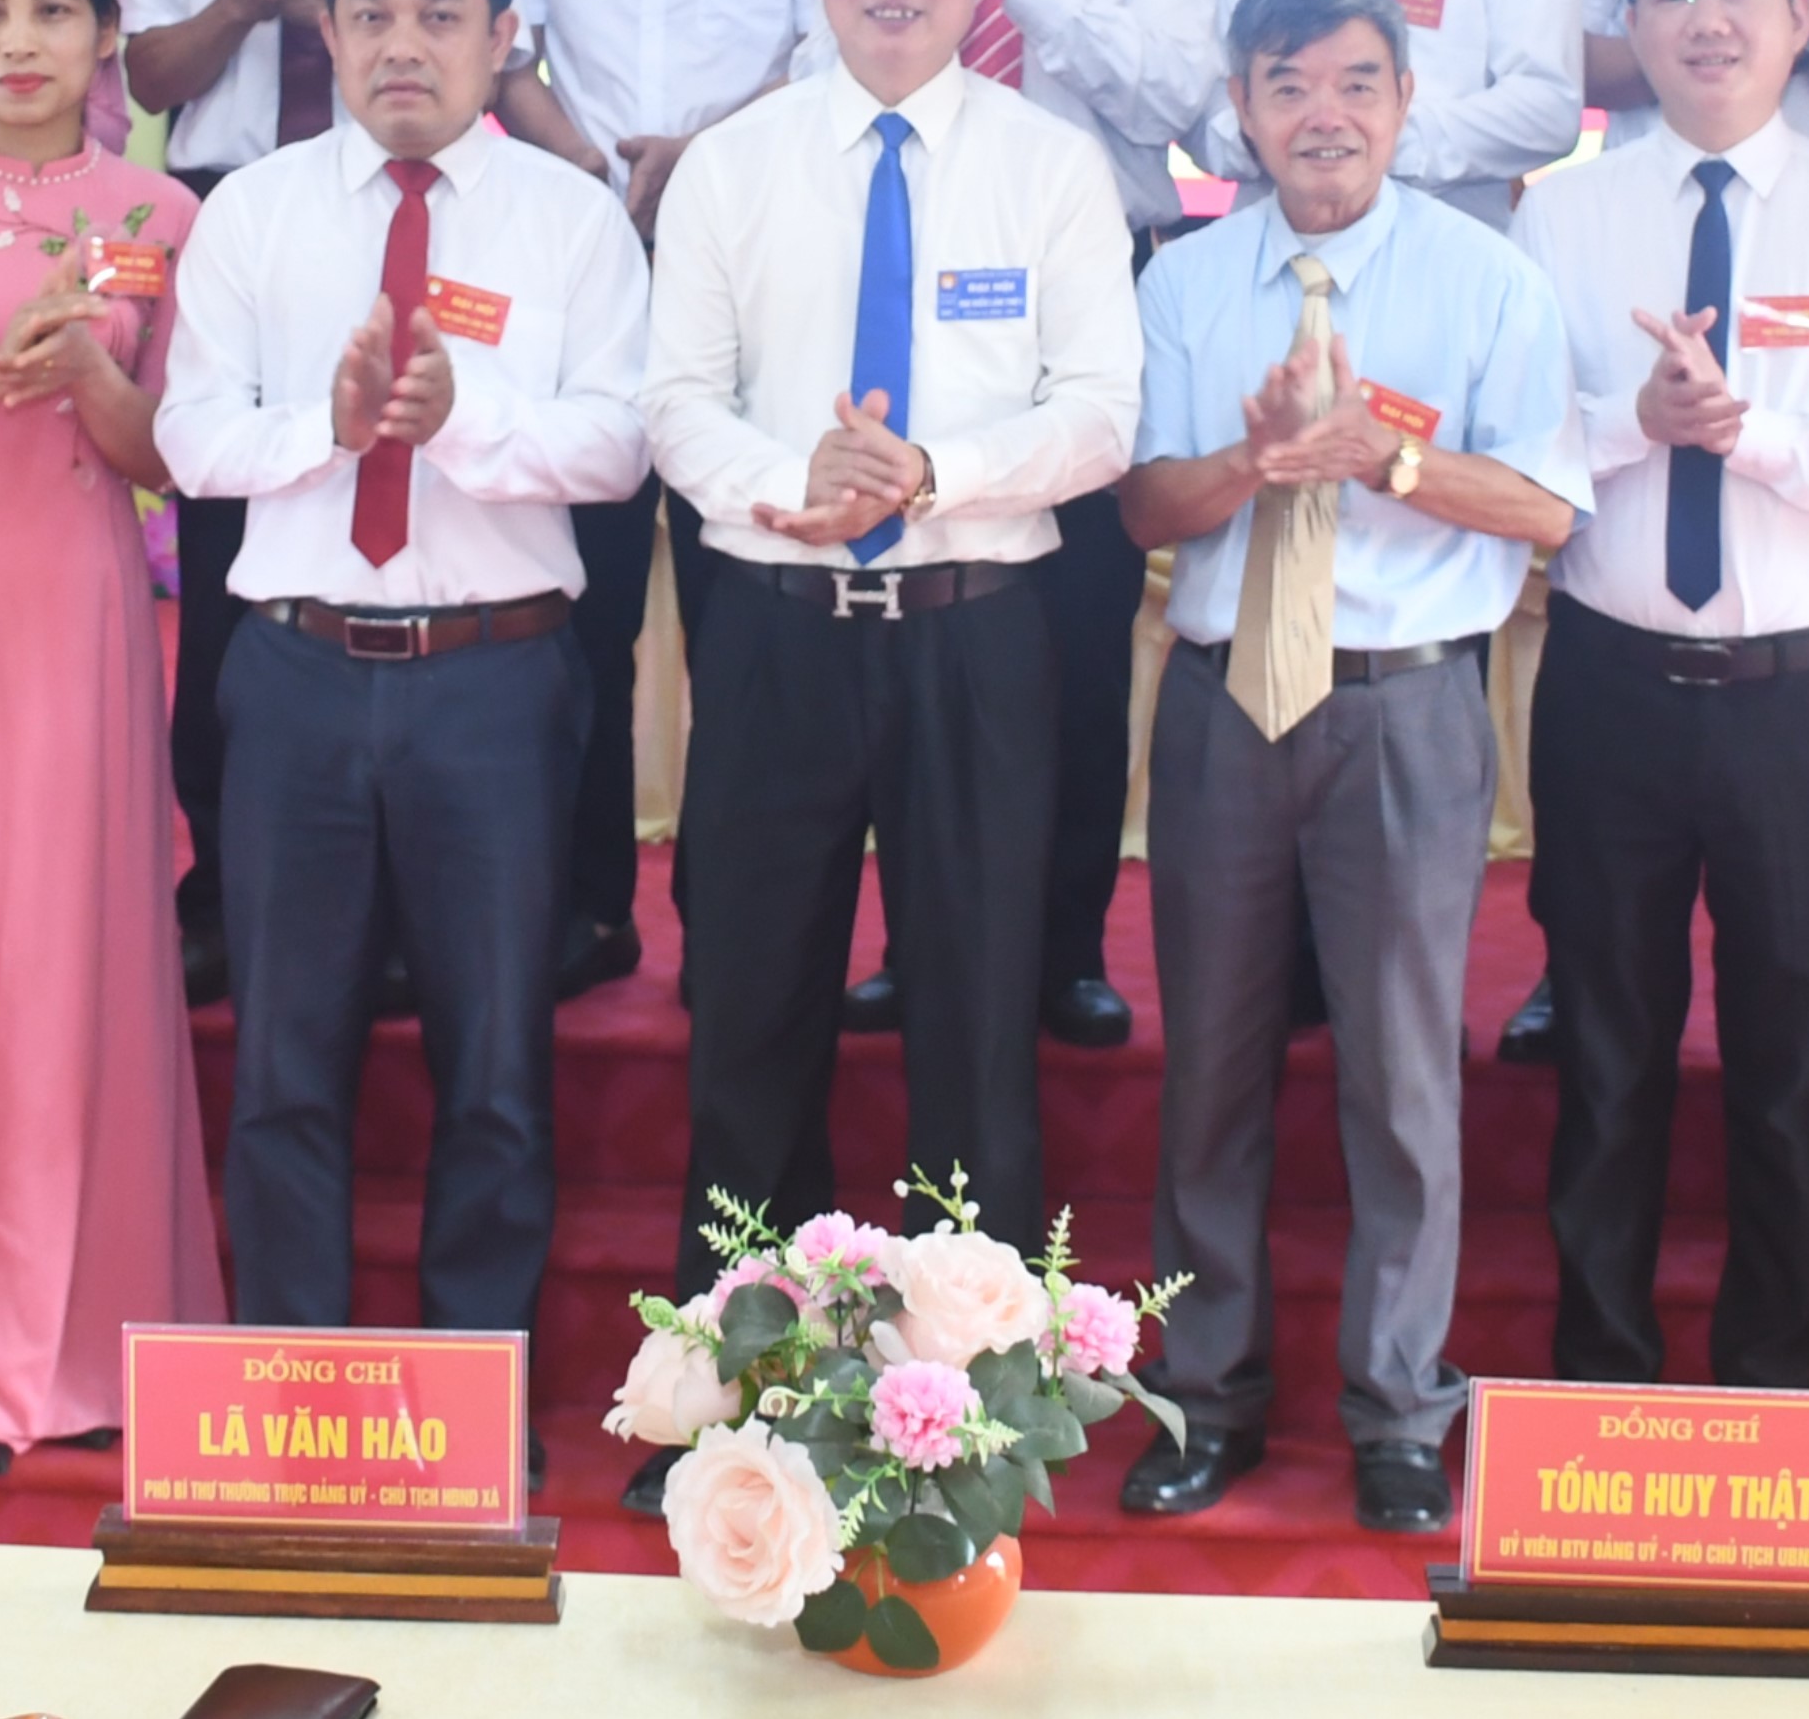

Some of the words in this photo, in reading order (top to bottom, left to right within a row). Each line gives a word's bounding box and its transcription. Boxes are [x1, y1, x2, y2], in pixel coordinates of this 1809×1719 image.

[243, 1348, 337, 1383] ĐỒNG
[345, 1356, 401, 1385] CHÍ
[198, 1404, 251, 1456] LÃ
[262, 1405, 348, 1459] VĂN
[1598, 1406, 1693, 1440] ĐỒNG
[1703, 1414, 1761, 1443] CHÍ
[1537, 1454, 1633, 1515] TỐNG
[1644, 1473, 1717, 1518] HUY
[1524, 1536, 1559, 1560] VIÊN
[1561, 1538, 1589, 1560] BTV
